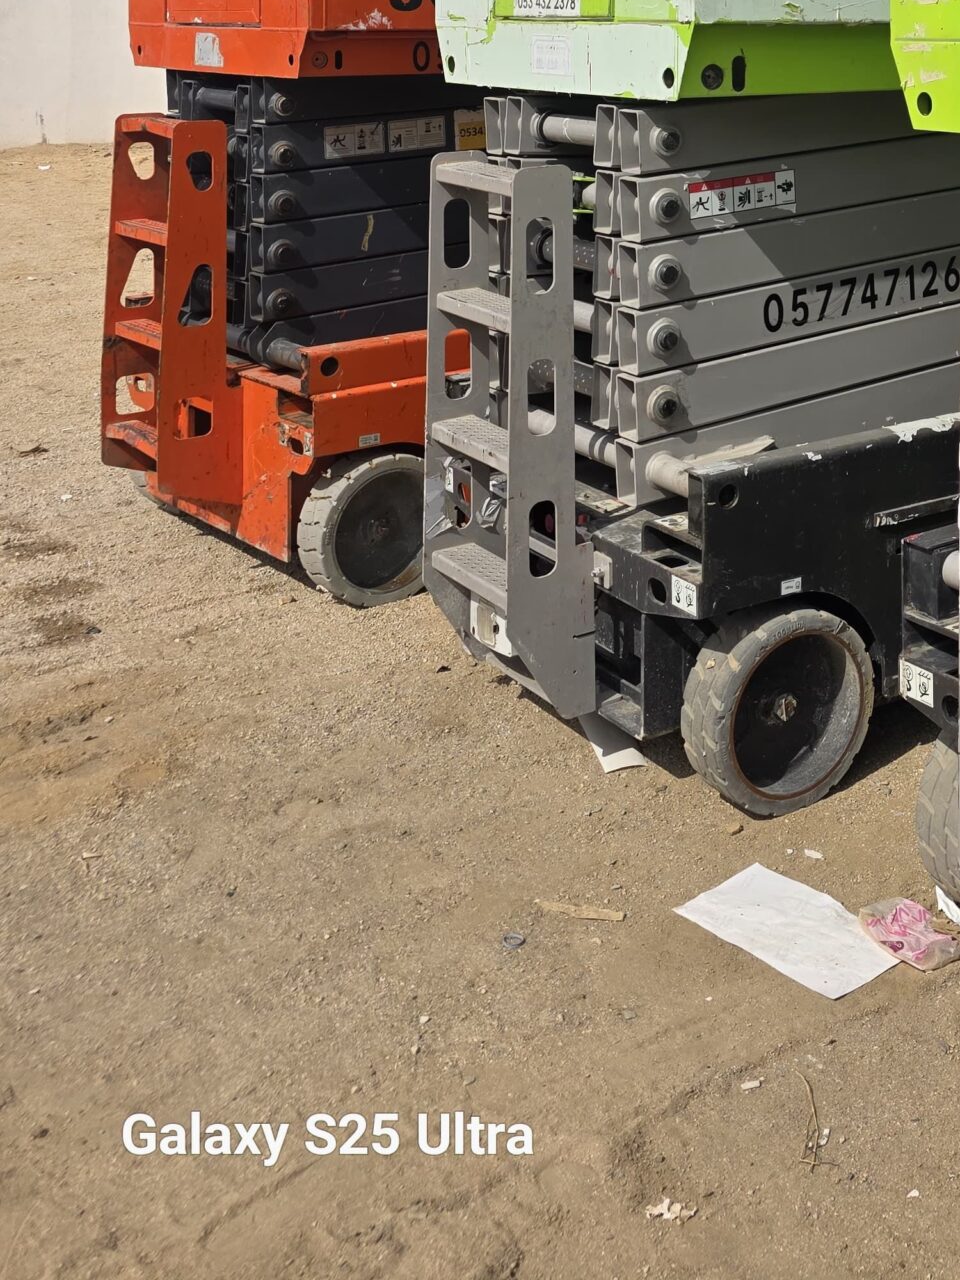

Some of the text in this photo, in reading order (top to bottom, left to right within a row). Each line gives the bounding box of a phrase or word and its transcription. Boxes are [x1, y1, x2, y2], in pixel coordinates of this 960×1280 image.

[412, 41, 444, 73] 0
[459, 127, 485, 138] 0534
[763, 255, 960, 333] 057747126
